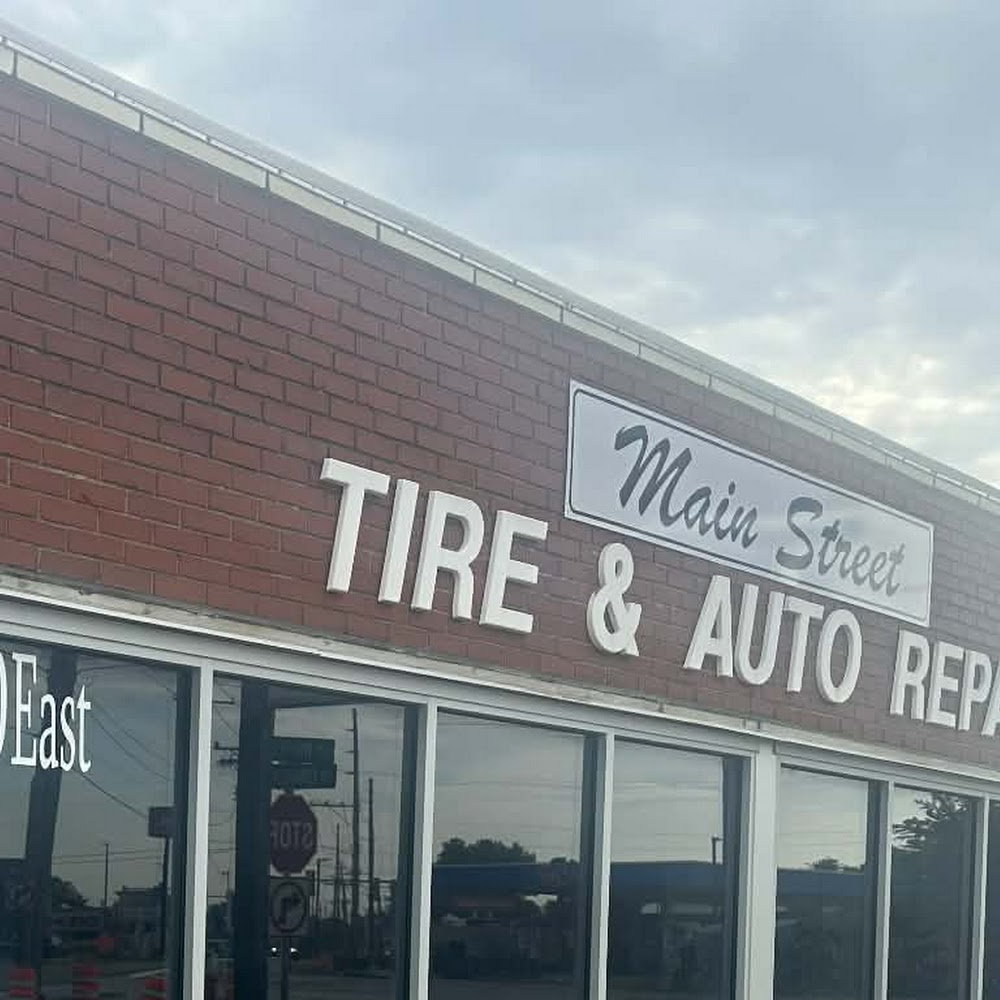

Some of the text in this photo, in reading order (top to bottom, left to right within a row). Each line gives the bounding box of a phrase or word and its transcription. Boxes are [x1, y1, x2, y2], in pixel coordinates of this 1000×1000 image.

[320, 457, 549, 634] TIRE
[586, 542, 642, 656] &
[682, 574, 863, 703] AUTO
[614, 424, 905, 596] Main Street
